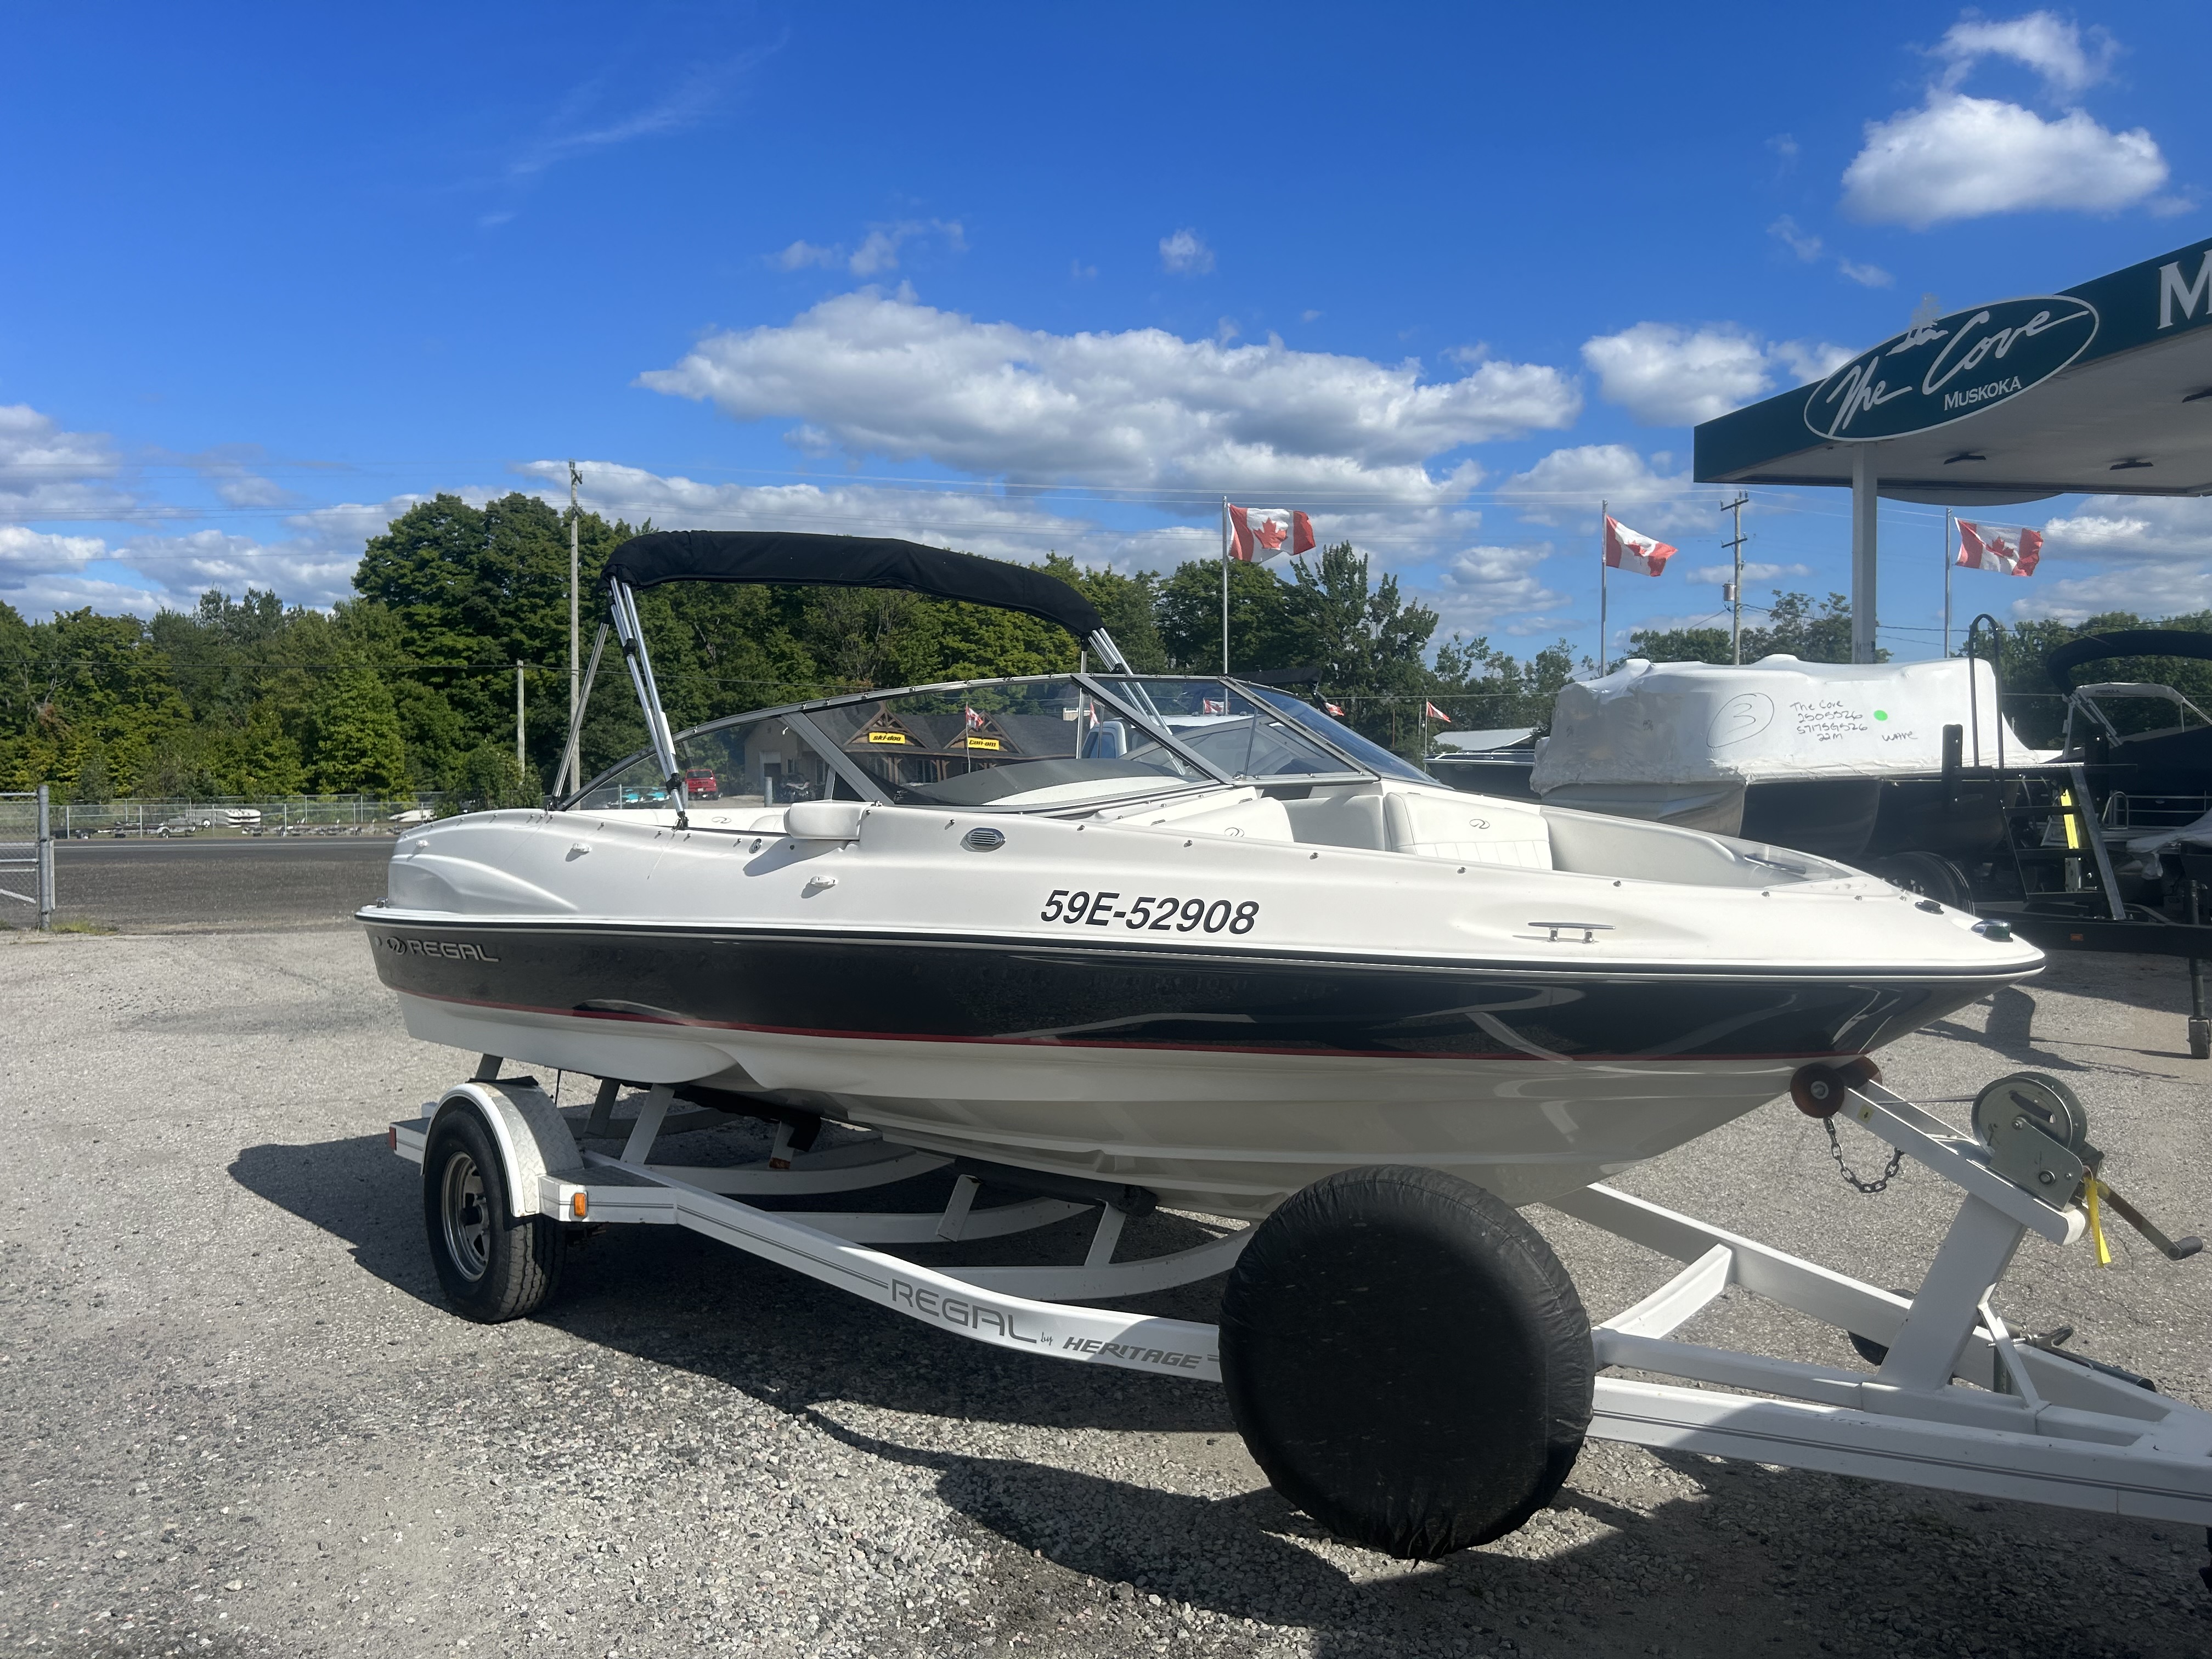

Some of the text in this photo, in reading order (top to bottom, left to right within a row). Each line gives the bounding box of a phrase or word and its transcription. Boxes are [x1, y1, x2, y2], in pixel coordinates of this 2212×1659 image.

[2157, 249, 2212, 329] M
[1826, 311, 2089, 437] The Cove
[1943, 376, 2022, 411] MUSKOKA
[1724, 703, 1756, 735] 3
[1790, 699, 1844, 712] The Cove
[1041, 890, 1260, 934] 59E-52908
[407, 939, 501, 962] REGAL
[891, 1278, 1203, 1369] REGAL by HERITAGE
